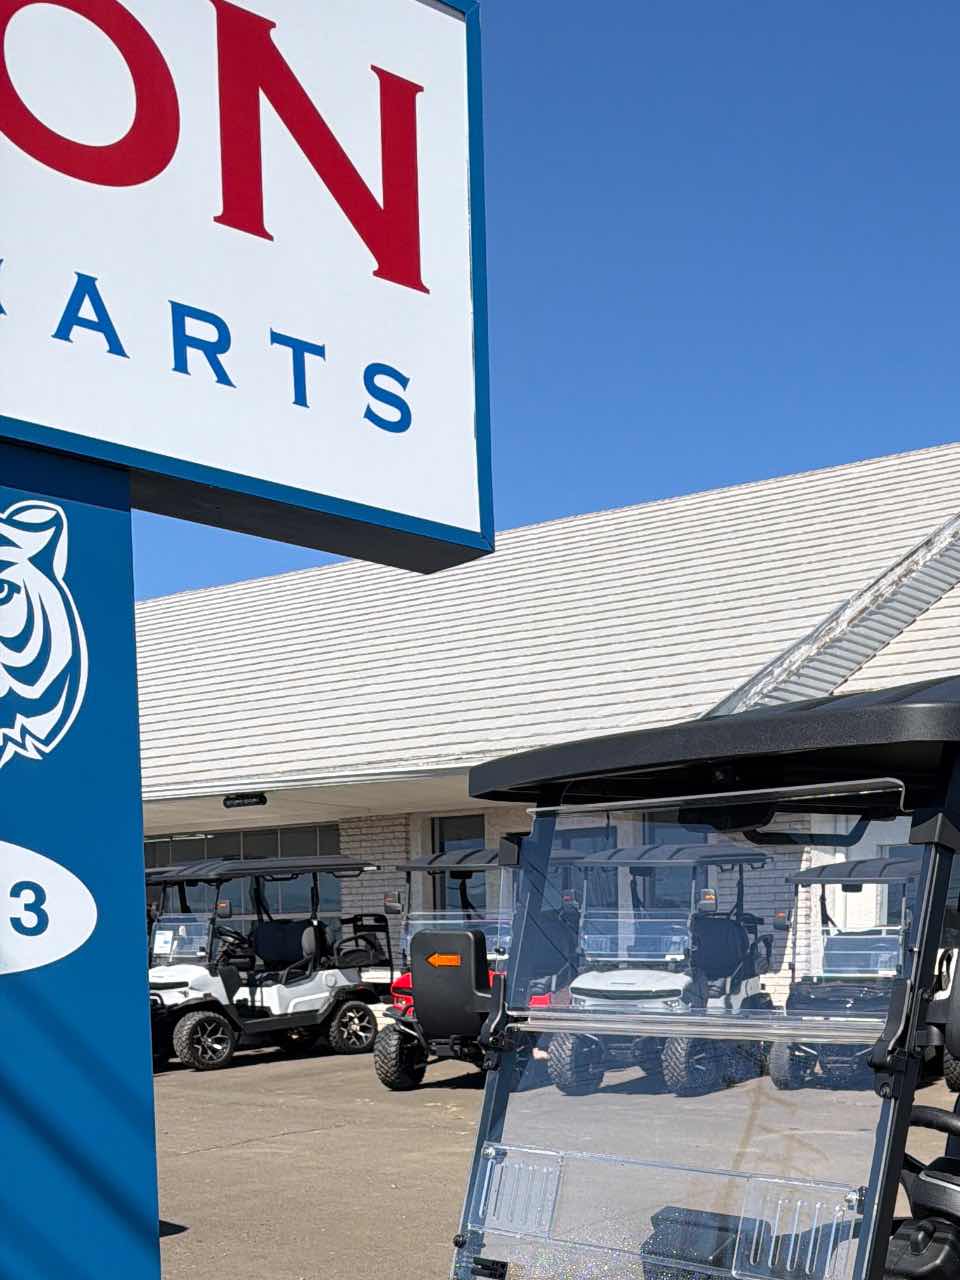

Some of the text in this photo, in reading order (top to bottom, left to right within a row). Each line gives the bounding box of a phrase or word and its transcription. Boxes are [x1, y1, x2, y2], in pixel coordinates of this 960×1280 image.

[0, 0, 429, 294] ON
[0, 258, 413, 434] ARTS
[9, 880, 50, 937] 3
